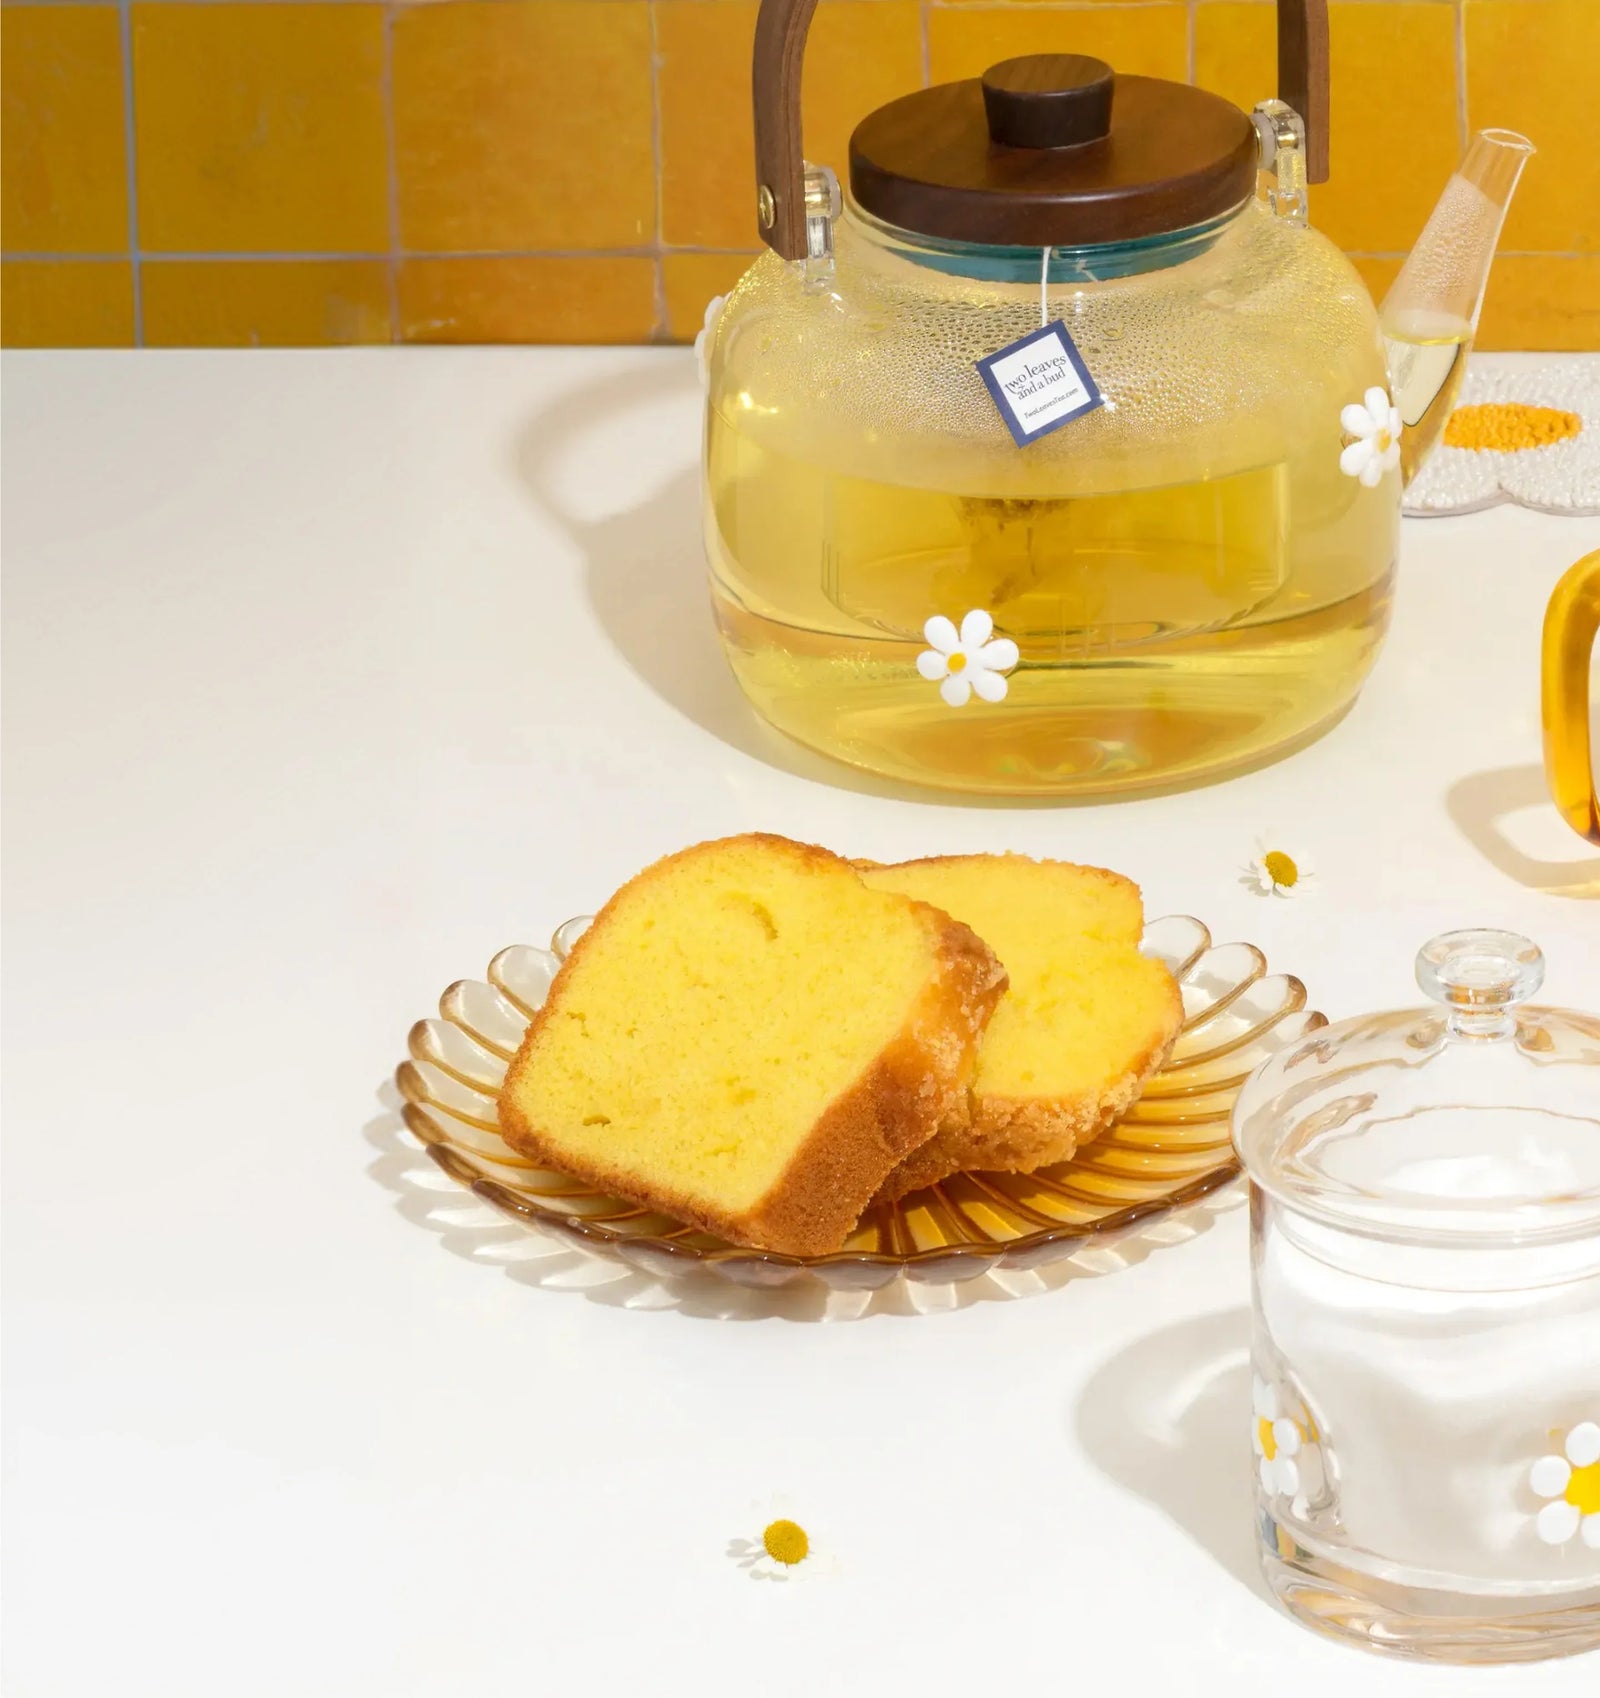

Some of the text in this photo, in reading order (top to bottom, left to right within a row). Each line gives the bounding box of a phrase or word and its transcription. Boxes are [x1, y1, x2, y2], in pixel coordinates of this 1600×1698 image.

[1004, 355, 1067, 395] two leaves
[1017, 366, 1066, 400] and a bud
